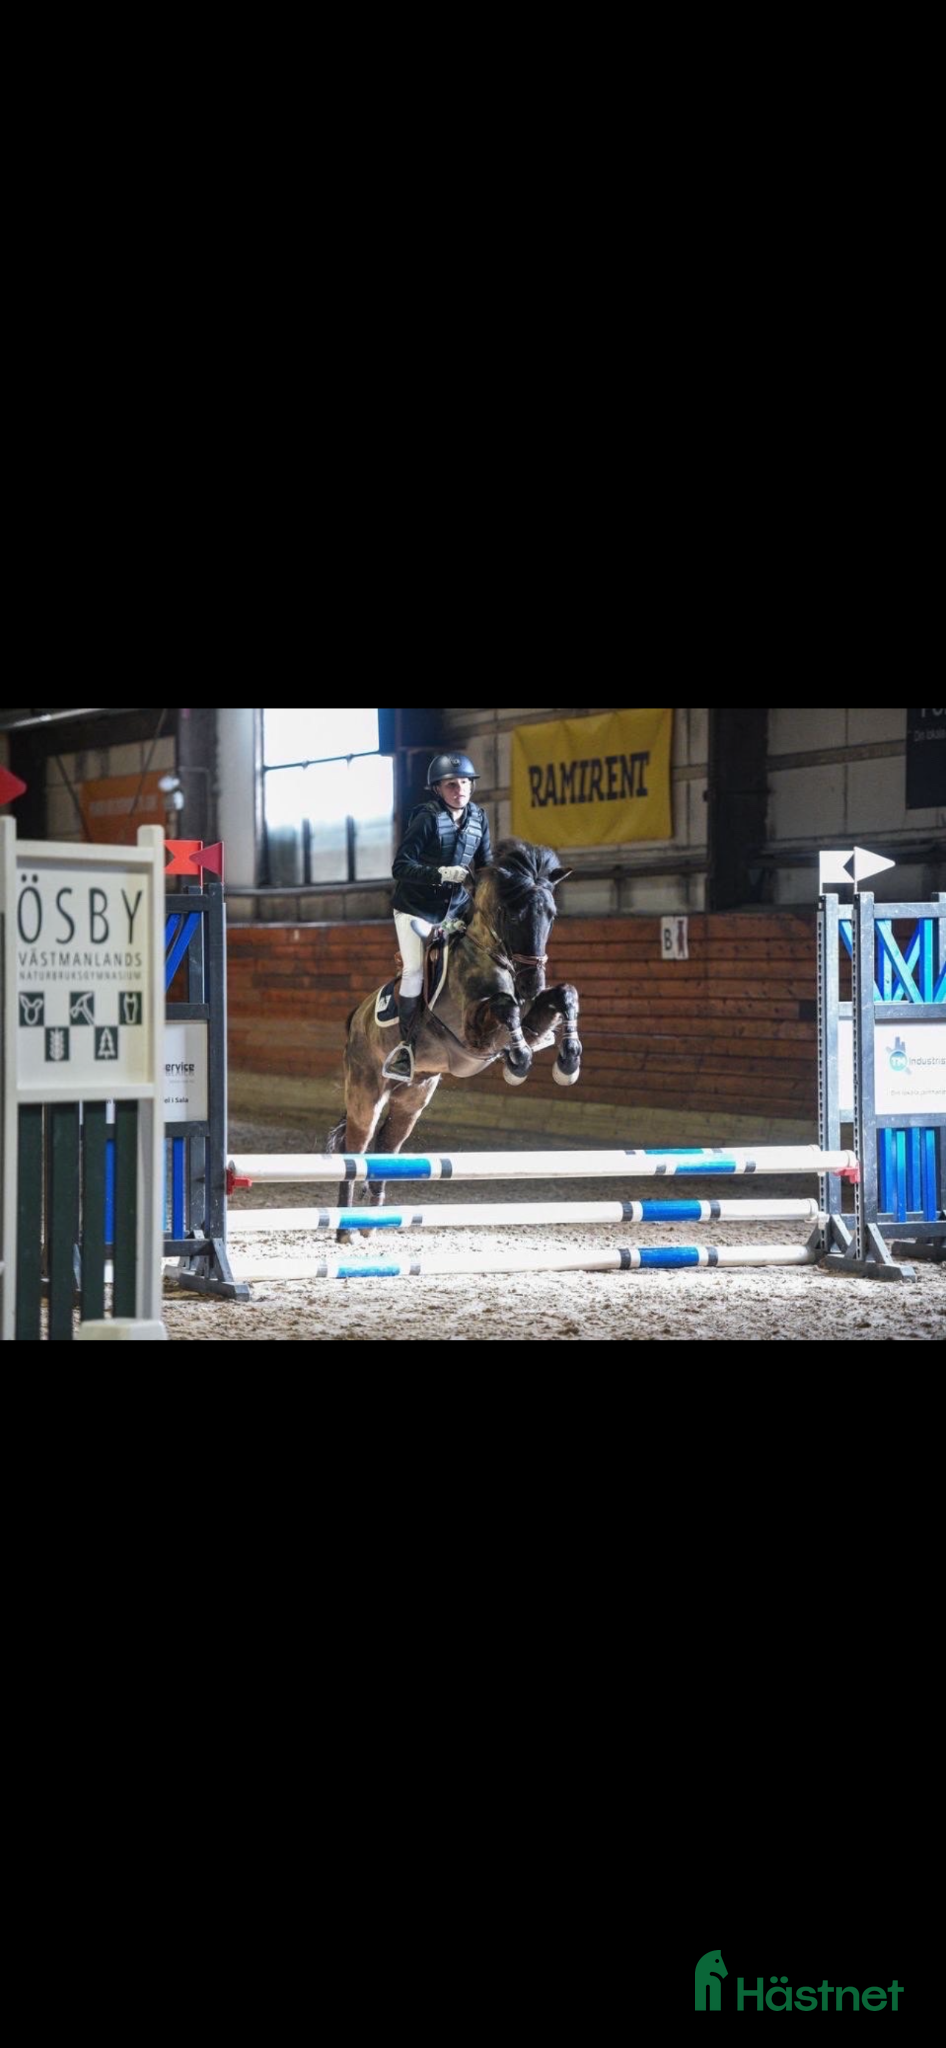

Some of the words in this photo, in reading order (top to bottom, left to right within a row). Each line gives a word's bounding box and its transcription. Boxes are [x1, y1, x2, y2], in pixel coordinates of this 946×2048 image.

[528, 751, 649, 808] RAMIRENT
[17, 873, 142, 944] ÖSBY
[664, 929, 672, 950] B
[18, 948, 142, 967] VÄSTMANLANDS
[19, 970, 142, 980] NATURBRUKSGYMNASIUM
